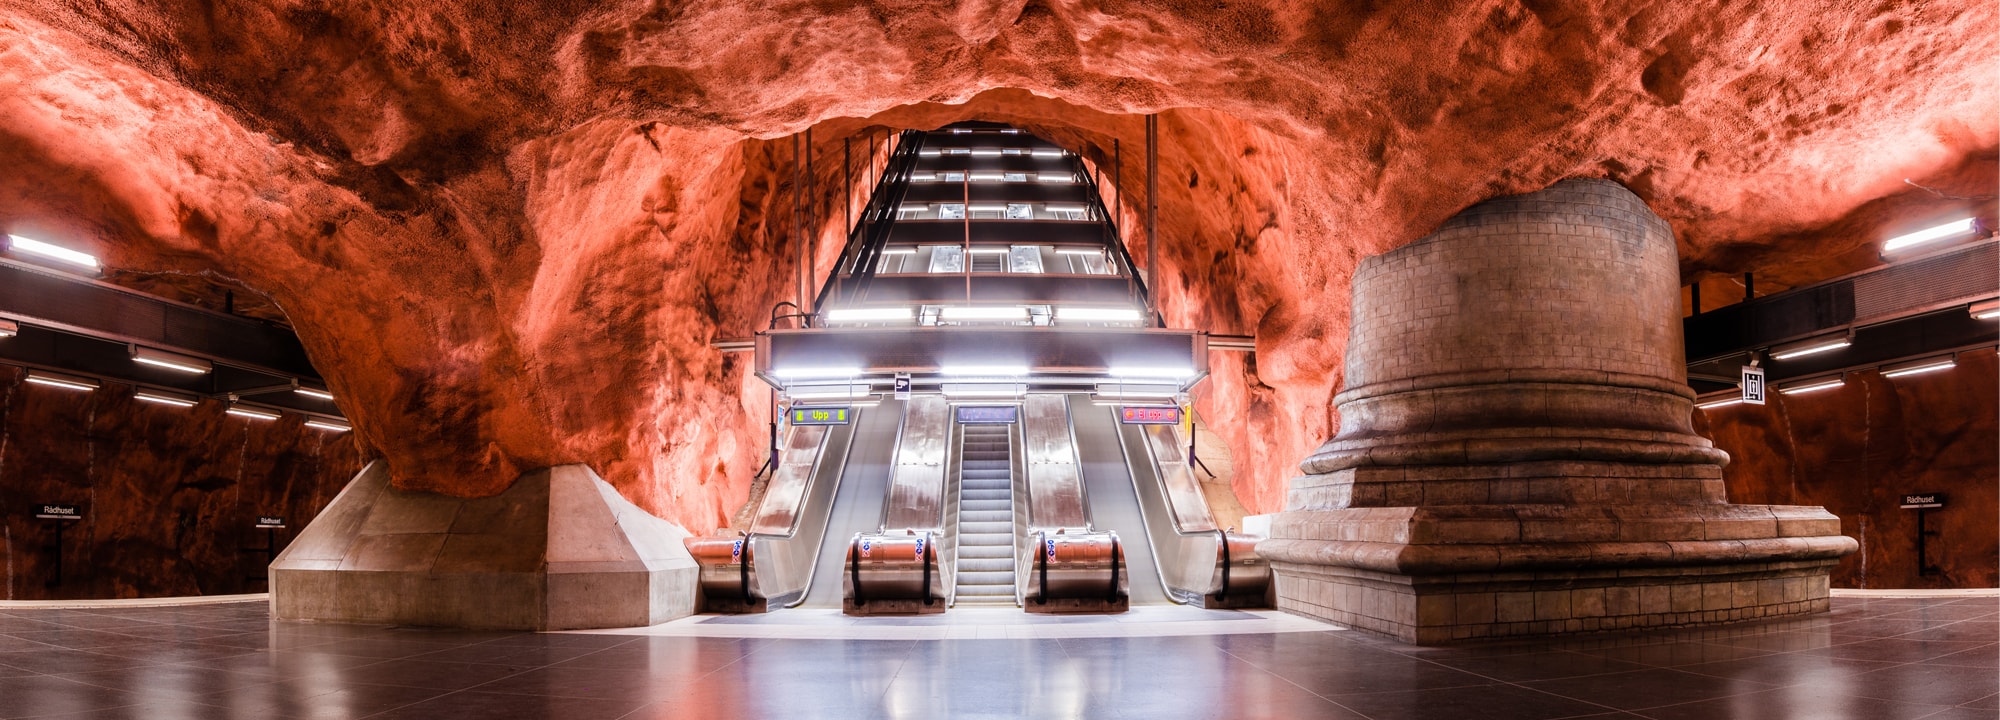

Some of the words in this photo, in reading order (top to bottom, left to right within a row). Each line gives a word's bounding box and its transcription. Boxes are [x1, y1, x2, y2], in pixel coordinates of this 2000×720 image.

[812, 409, 829, 421] Upp
[1906, 495, 1935, 504] Rådhuset
[43, 505, 74, 515] Rådhuset
